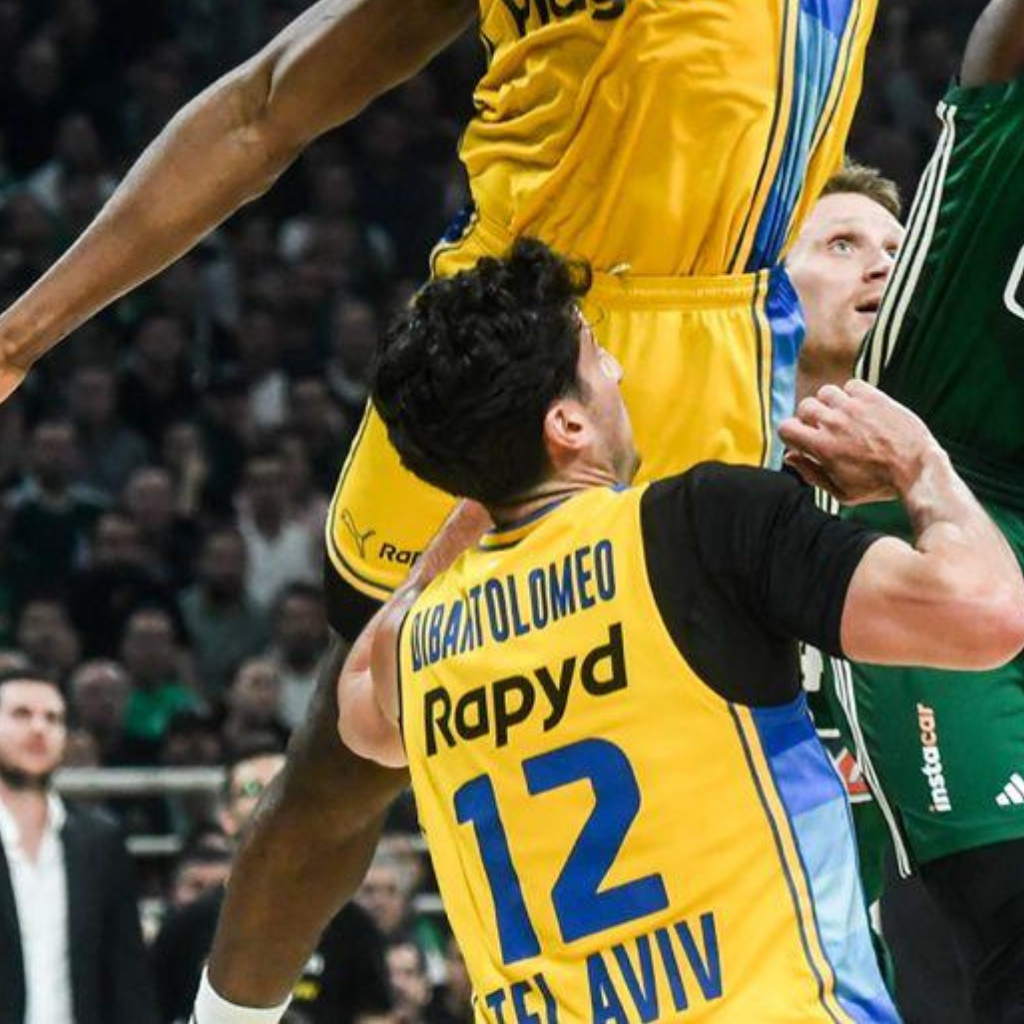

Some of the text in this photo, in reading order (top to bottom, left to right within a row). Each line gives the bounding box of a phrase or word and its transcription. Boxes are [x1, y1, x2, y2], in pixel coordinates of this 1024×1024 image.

[423, 623, 628, 756] Rapyd
[916, 702, 952, 812] instacar
[453, 737, 670, 965] 12
[586, 912, 723, 1024] AVIV
